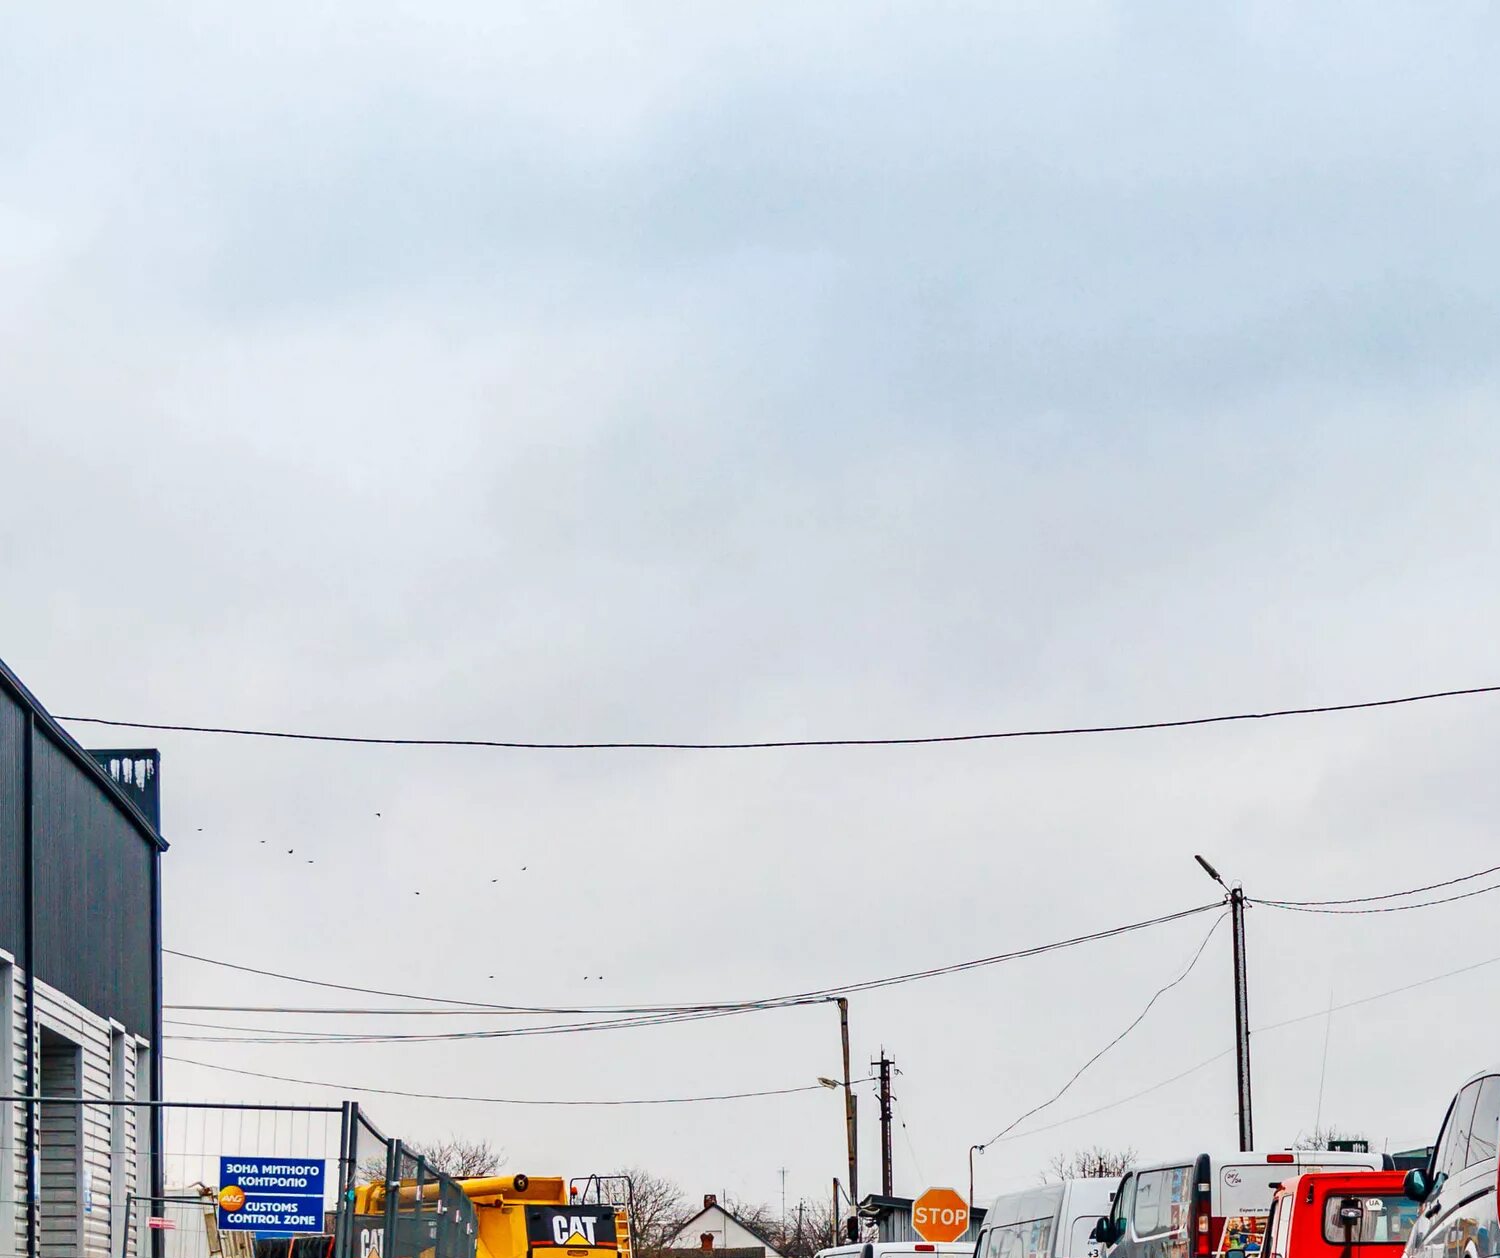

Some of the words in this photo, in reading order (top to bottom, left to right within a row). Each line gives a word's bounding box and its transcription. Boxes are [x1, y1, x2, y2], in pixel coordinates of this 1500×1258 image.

[226, 1164, 259, 1174] ЗОНА
[262, 1165, 319, 1176] МИТНОГО
[238, 1177, 307, 1187] КОНТРОЛЮ
[245, 1202, 298, 1212] CUSTOMS
[227, 1214, 281, 1224] CONTROL
[284, 1215, 315, 1225] ZONE
[915, 1207, 967, 1225] STOP
[552, 1215, 598, 1246] CAT
